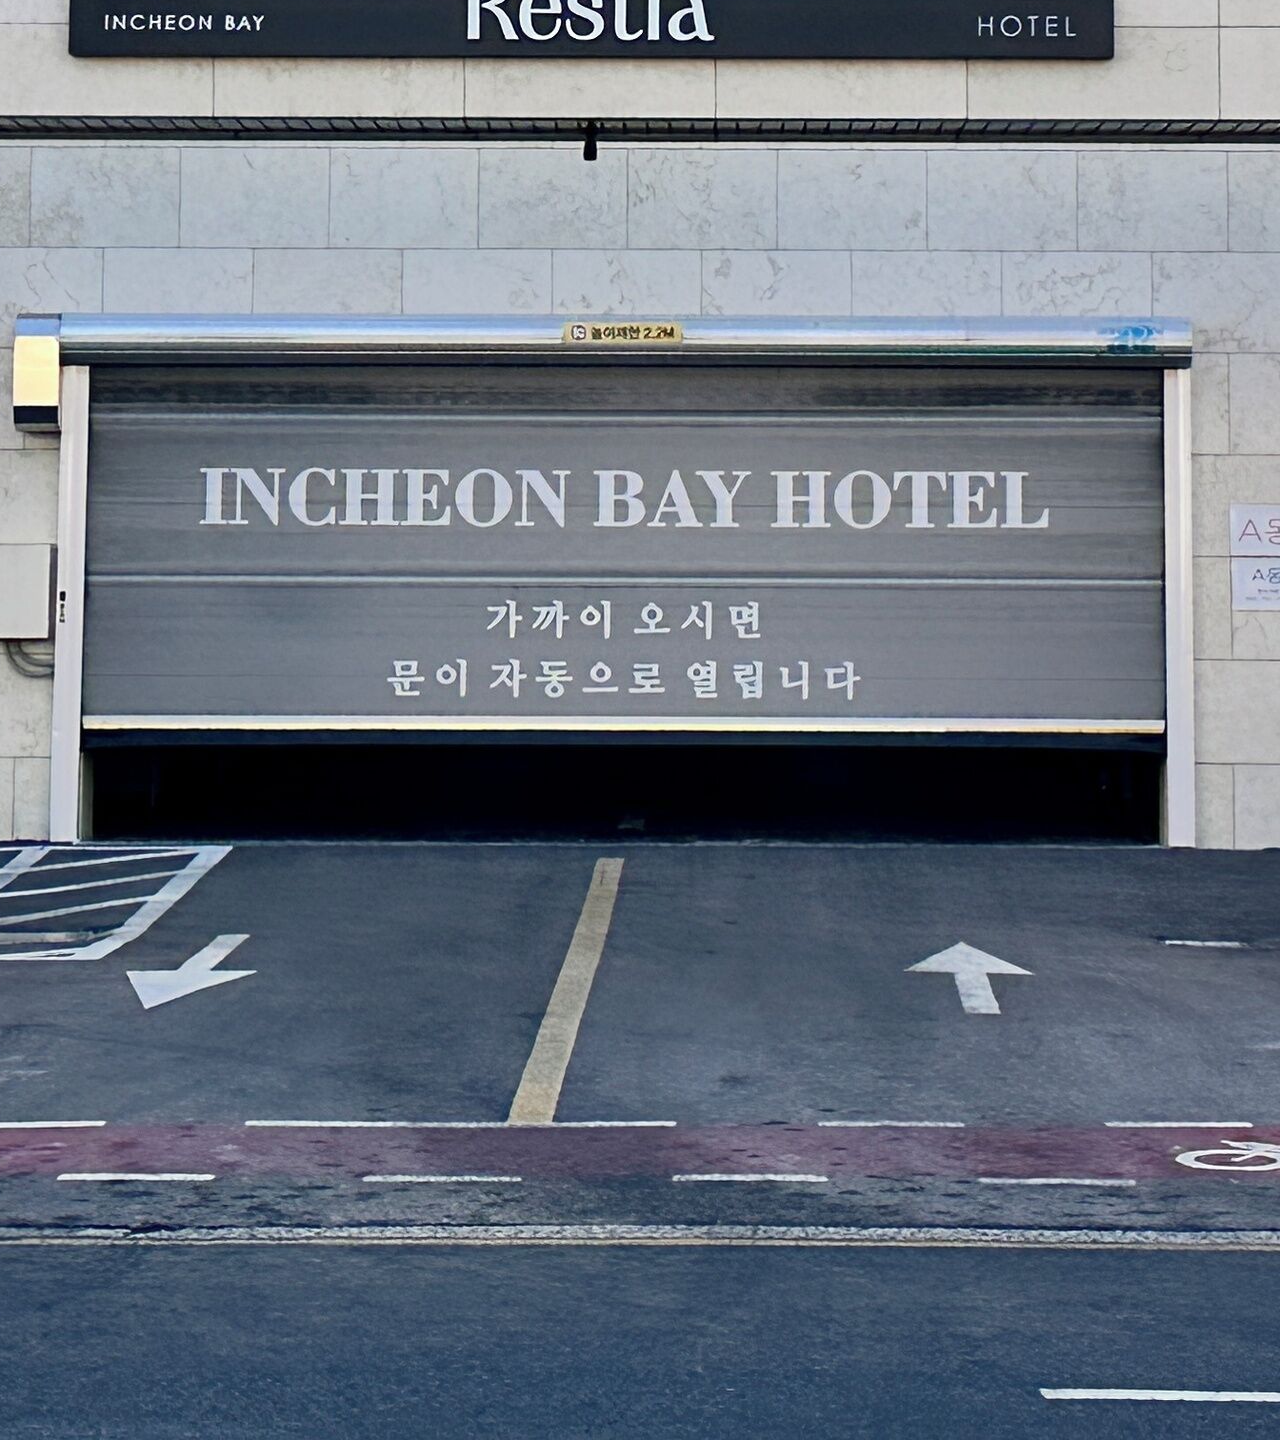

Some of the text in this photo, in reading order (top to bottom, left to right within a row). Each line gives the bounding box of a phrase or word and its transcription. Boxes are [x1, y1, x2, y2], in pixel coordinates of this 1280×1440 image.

[104, 14, 265, 31] INCHEON BAY
[977, 15, 1077, 37] HOTEL
[199, 467, 1050, 529] INCHEON BAY HOTEL
[487, 600, 761, 640] 가까이 오시면
[386, 658, 862, 700] 문이 자동으로 열립니다
